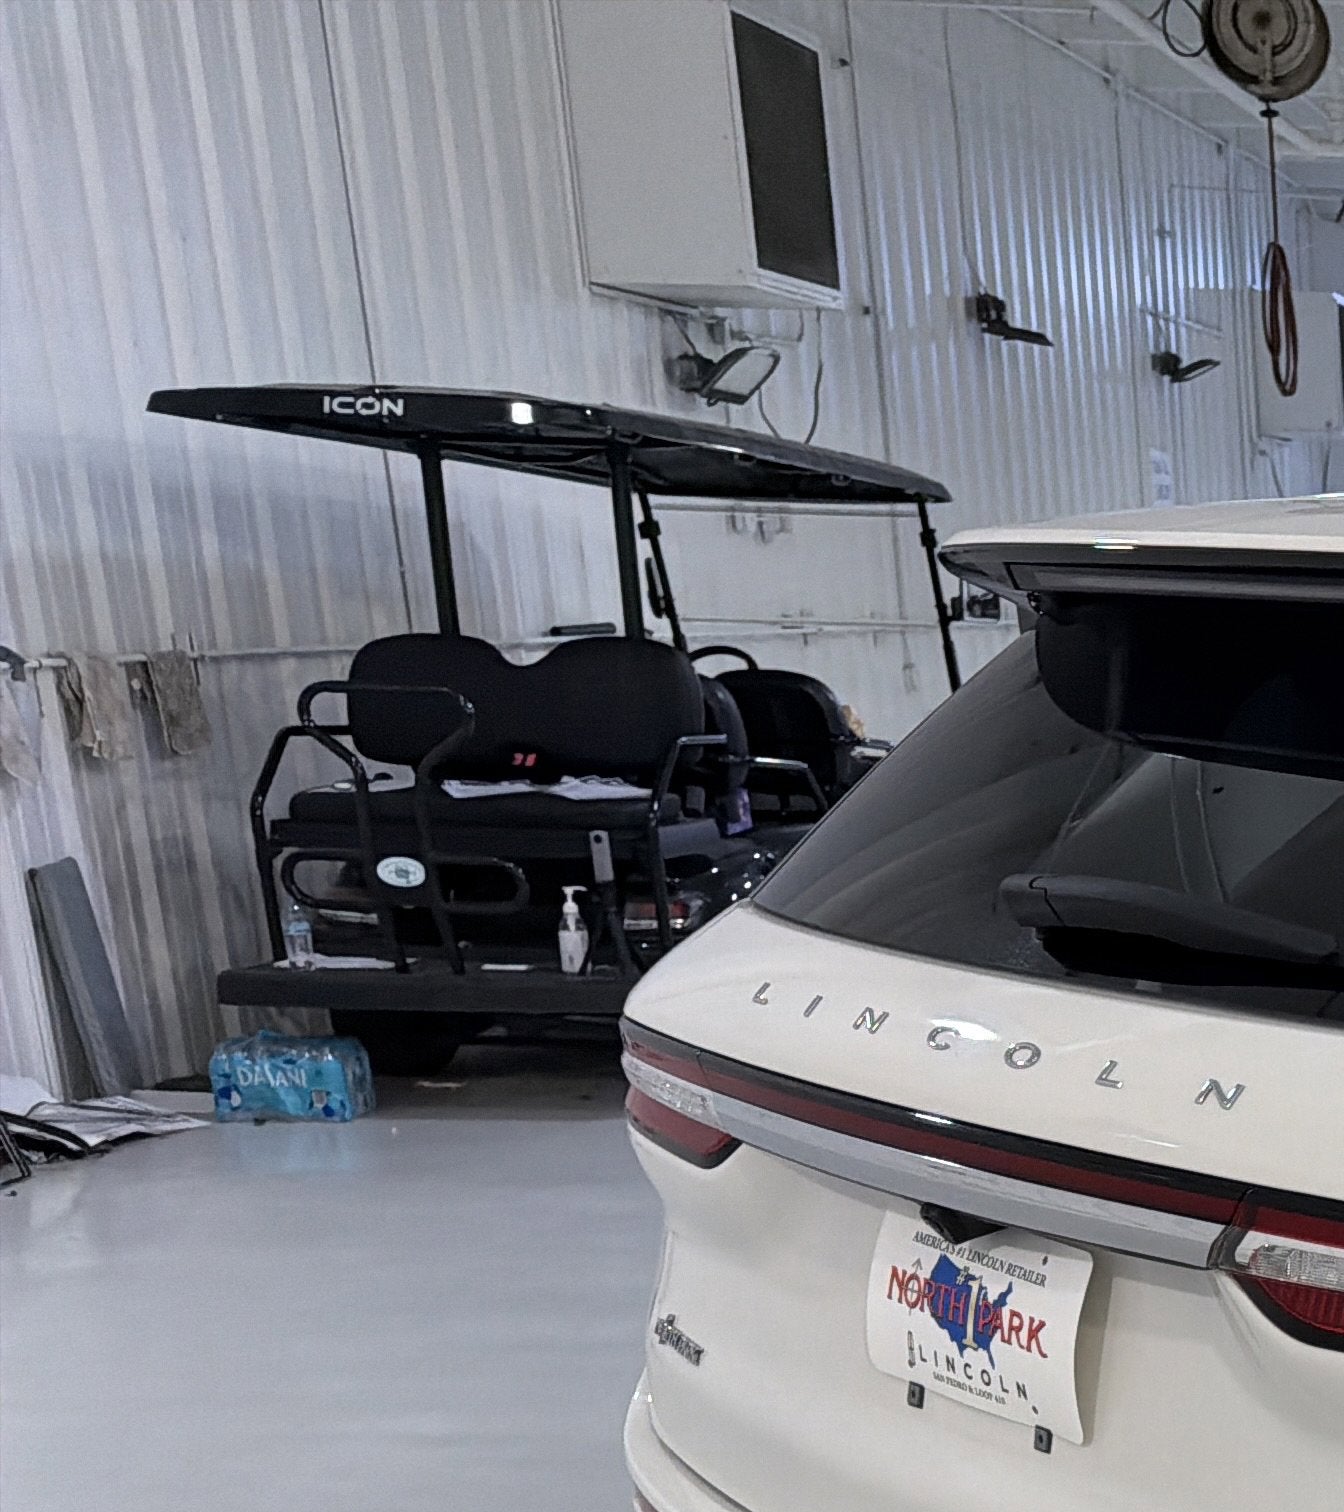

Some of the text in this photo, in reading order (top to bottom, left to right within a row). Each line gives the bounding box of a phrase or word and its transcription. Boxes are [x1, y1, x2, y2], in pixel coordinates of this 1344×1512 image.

[323, 395, 404, 416] ICON
[751, 982, 1246, 1111] LINCOLN
[965, 1248, 1007, 1273] LINCOLN
[1004, 1263, 1047, 1288] RETAILER
[886, 1265, 965, 1325] NORTH
[977, 1299, 1049, 1359] PARK
[917, 1343, 1029, 1401] LINCOLN
